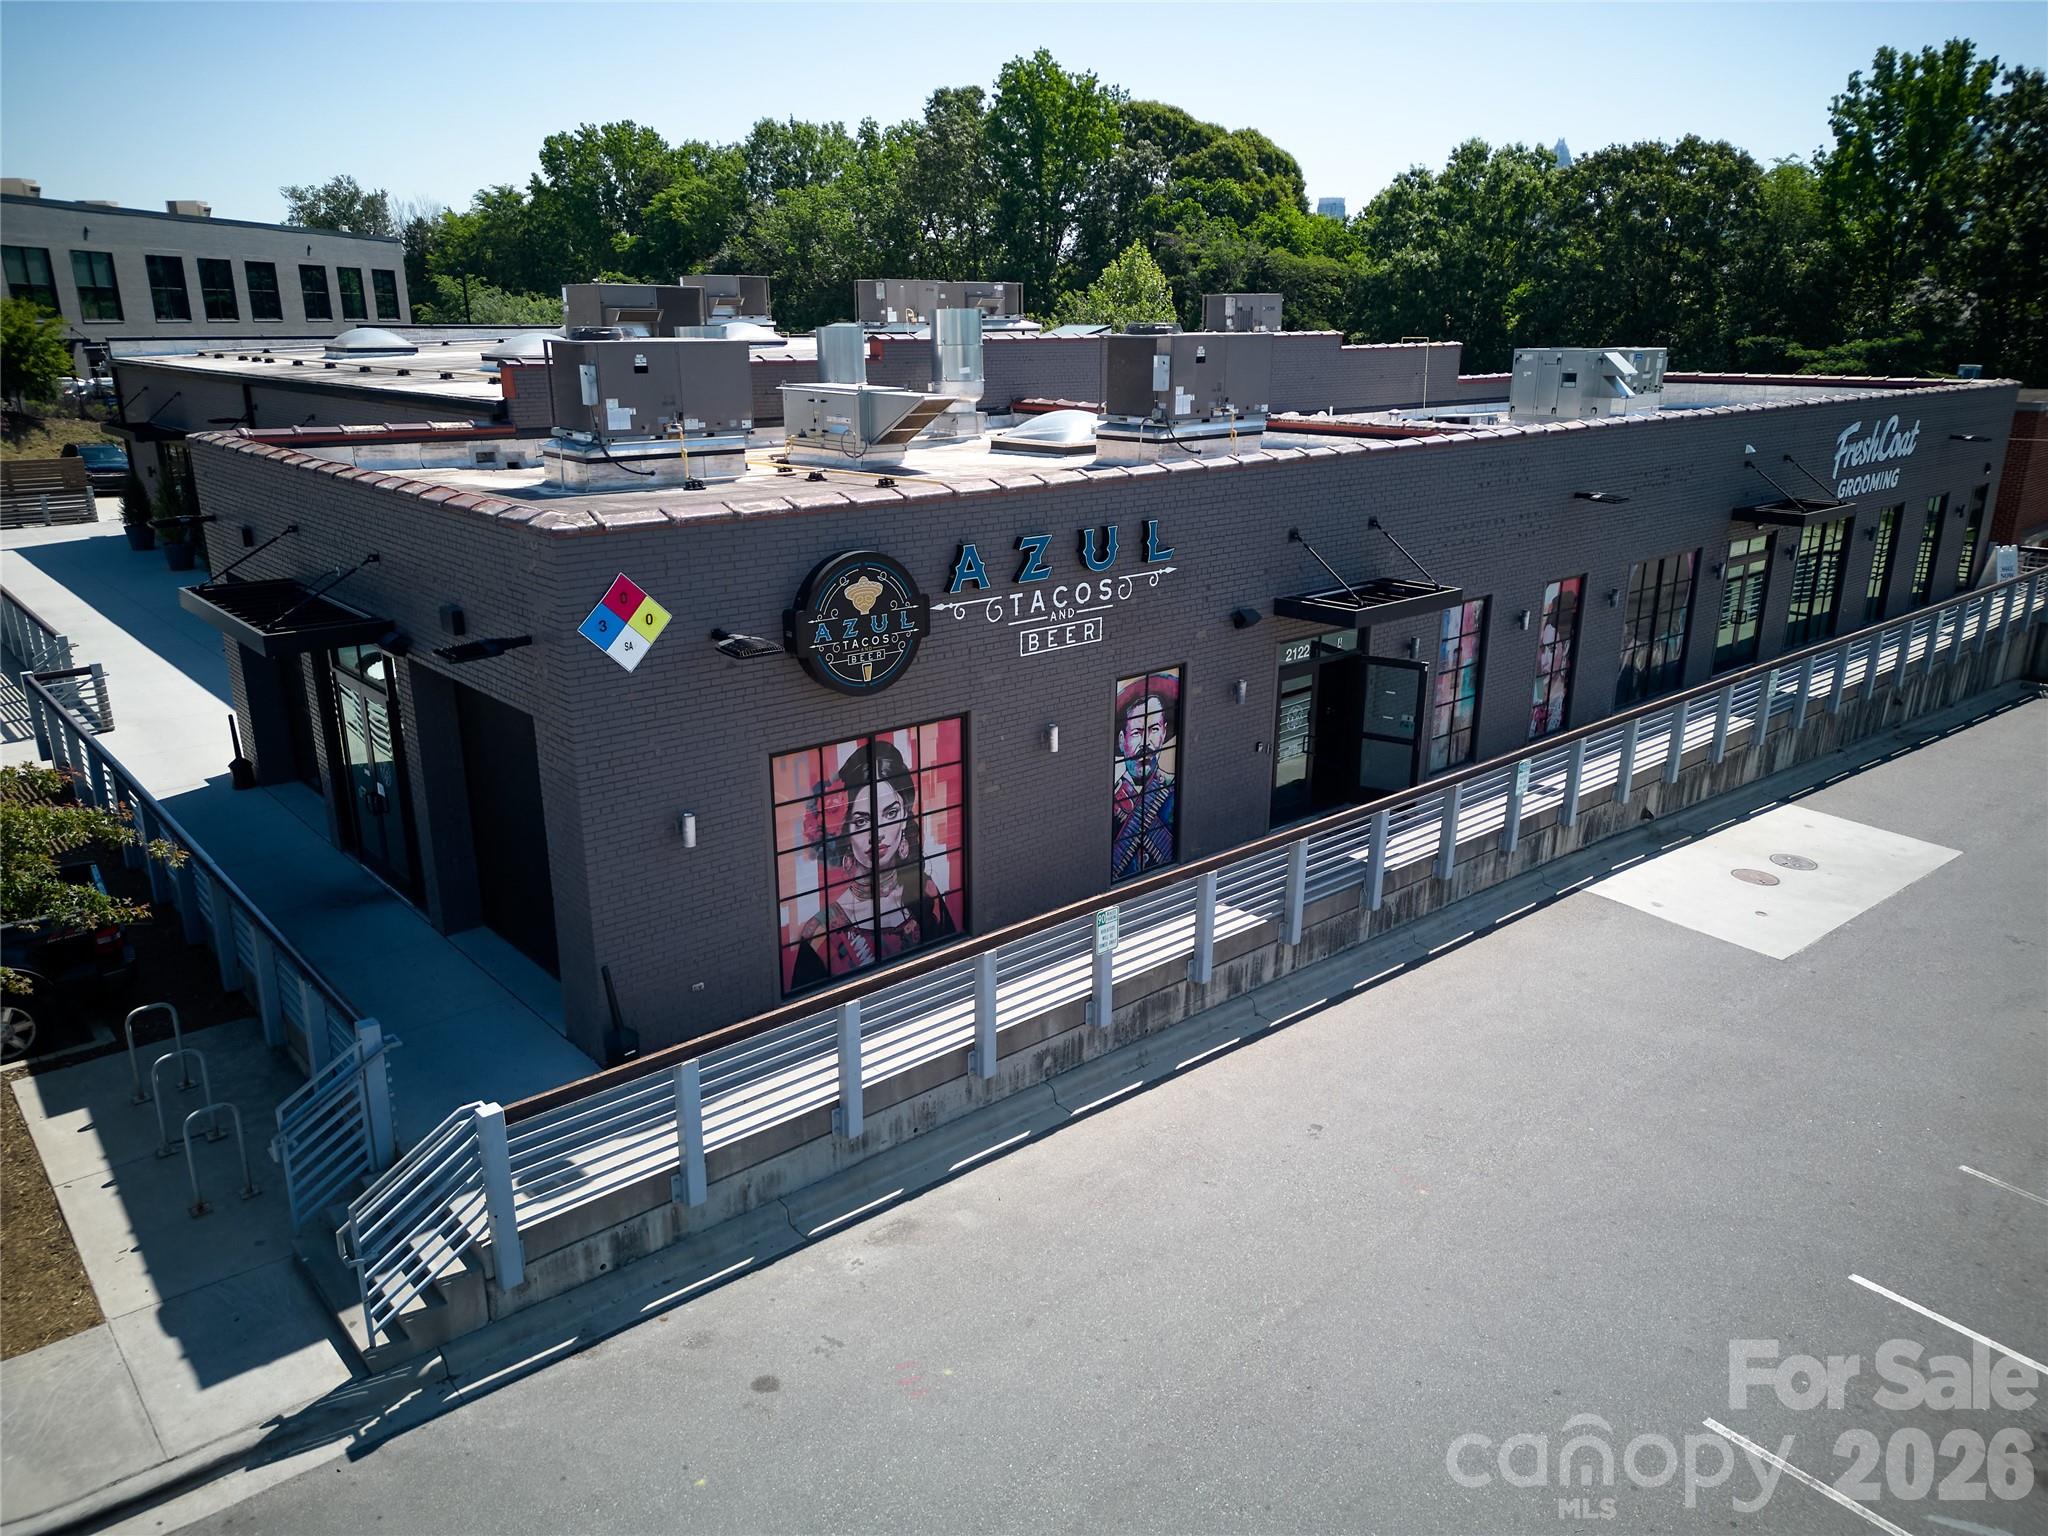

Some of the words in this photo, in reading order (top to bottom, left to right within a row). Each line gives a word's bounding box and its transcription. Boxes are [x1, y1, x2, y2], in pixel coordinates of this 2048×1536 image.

[1837, 467, 1900, 499] GROOMING
[948, 519, 1175, 593] AZUL
[619, 592, 628, 605] 0
[1009, 578, 1114, 616] TACOS
[645, 613, 654, 626] 0
[1050, 607, 1076, 622] AND
[598, 620, 608, 633] 3
[814, 611, 915, 643] AZUL
[843, 633, 890, 651] TACOS
[1028, 622, 1096, 652] BEER
[624, 641, 634, 652] SA
[1285, 644, 1310, 662] 2122
[851, 651, 882, 663] BEER
